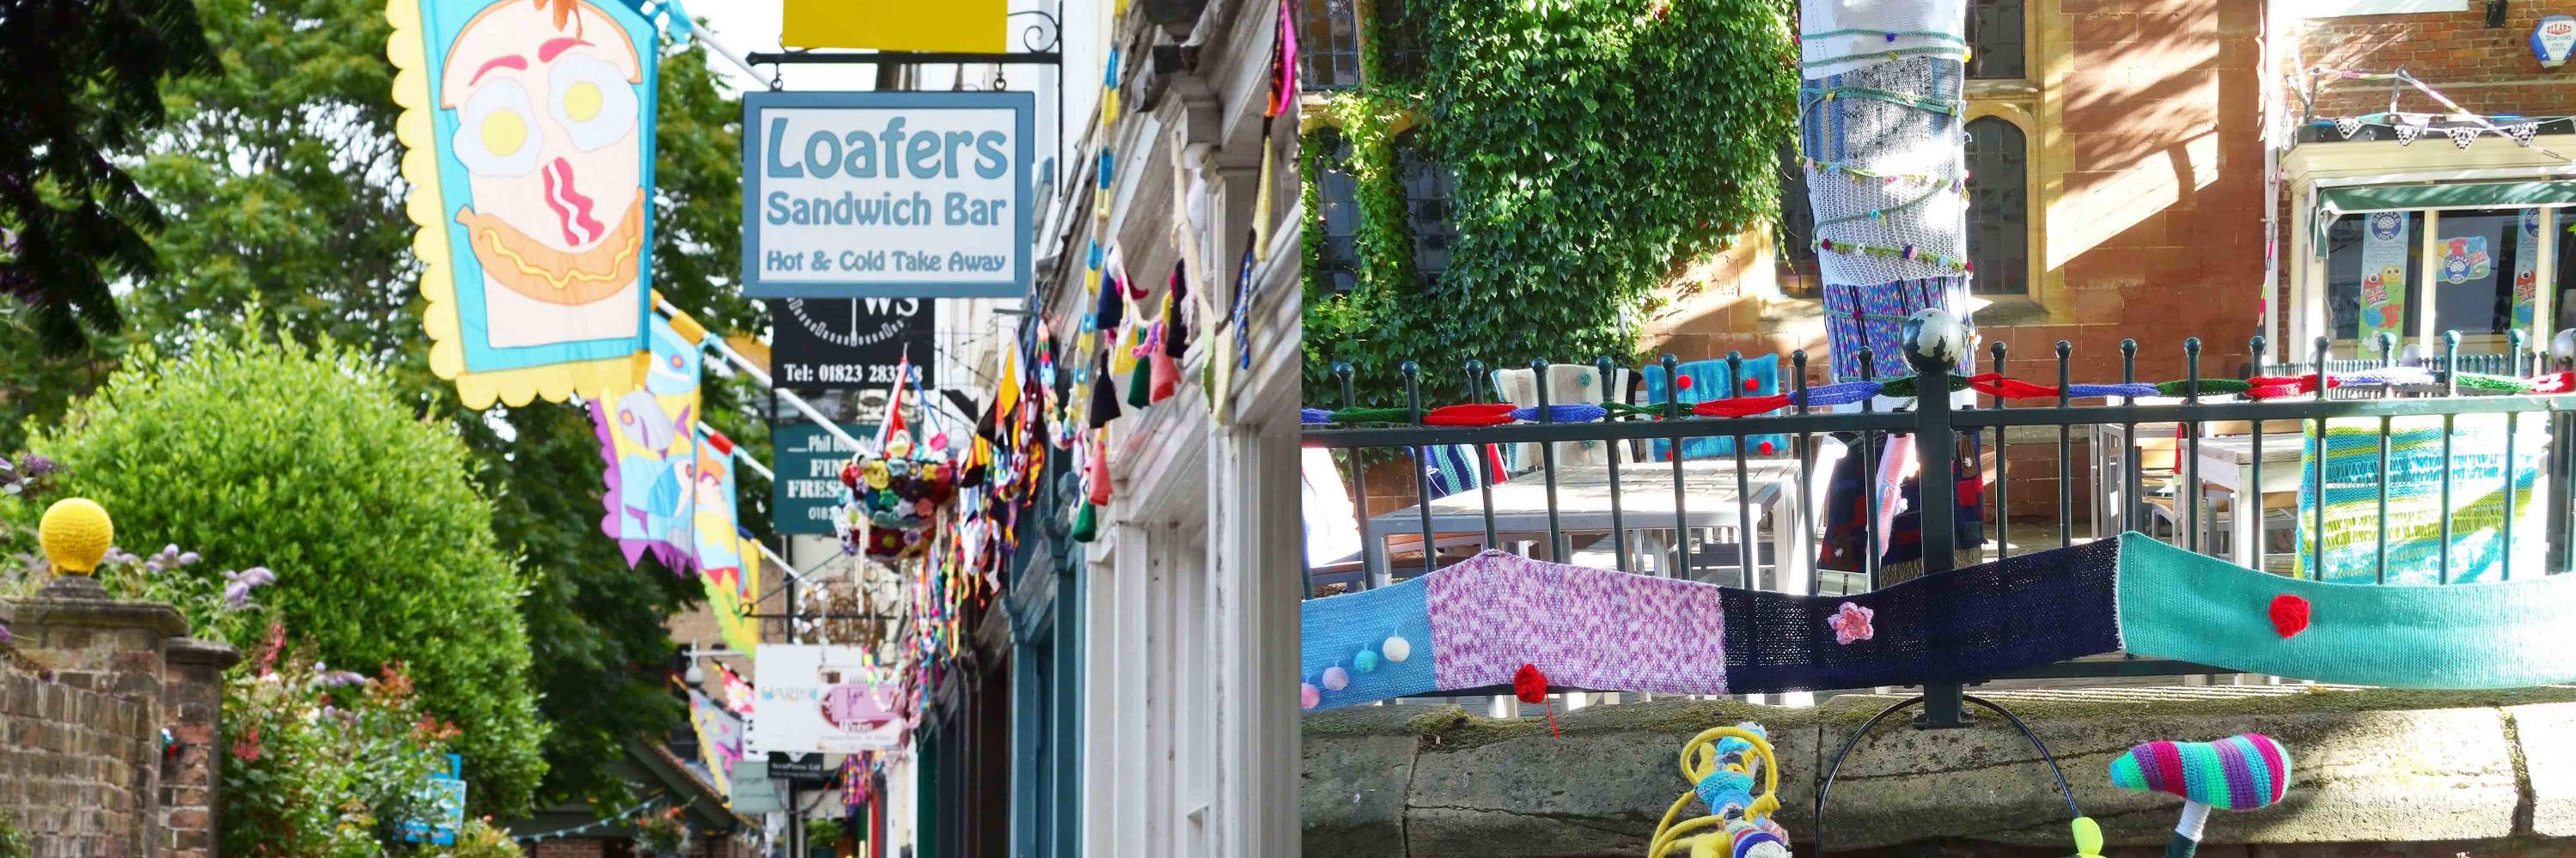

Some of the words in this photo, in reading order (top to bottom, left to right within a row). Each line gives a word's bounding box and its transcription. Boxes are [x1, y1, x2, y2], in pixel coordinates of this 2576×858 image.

[767, 116, 1008, 180] Loafers
[766, 191, 931, 226] Sandwich
[944, 192, 1007, 226] Bar
[766, 250, 804, 271] Hot
[811, 250, 832, 272] &
[839, 250, 886, 272] Cold
[891, 250, 942, 272] Take
[948, 251, 1006, 273] Away
[784, 363, 814, 382] Tel:
[818, 363, 863, 383] 01823
[808, 435, 831, 453] Phil
[810, 459, 846, 478] FIN
[786, 479, 844, 498] FRES
